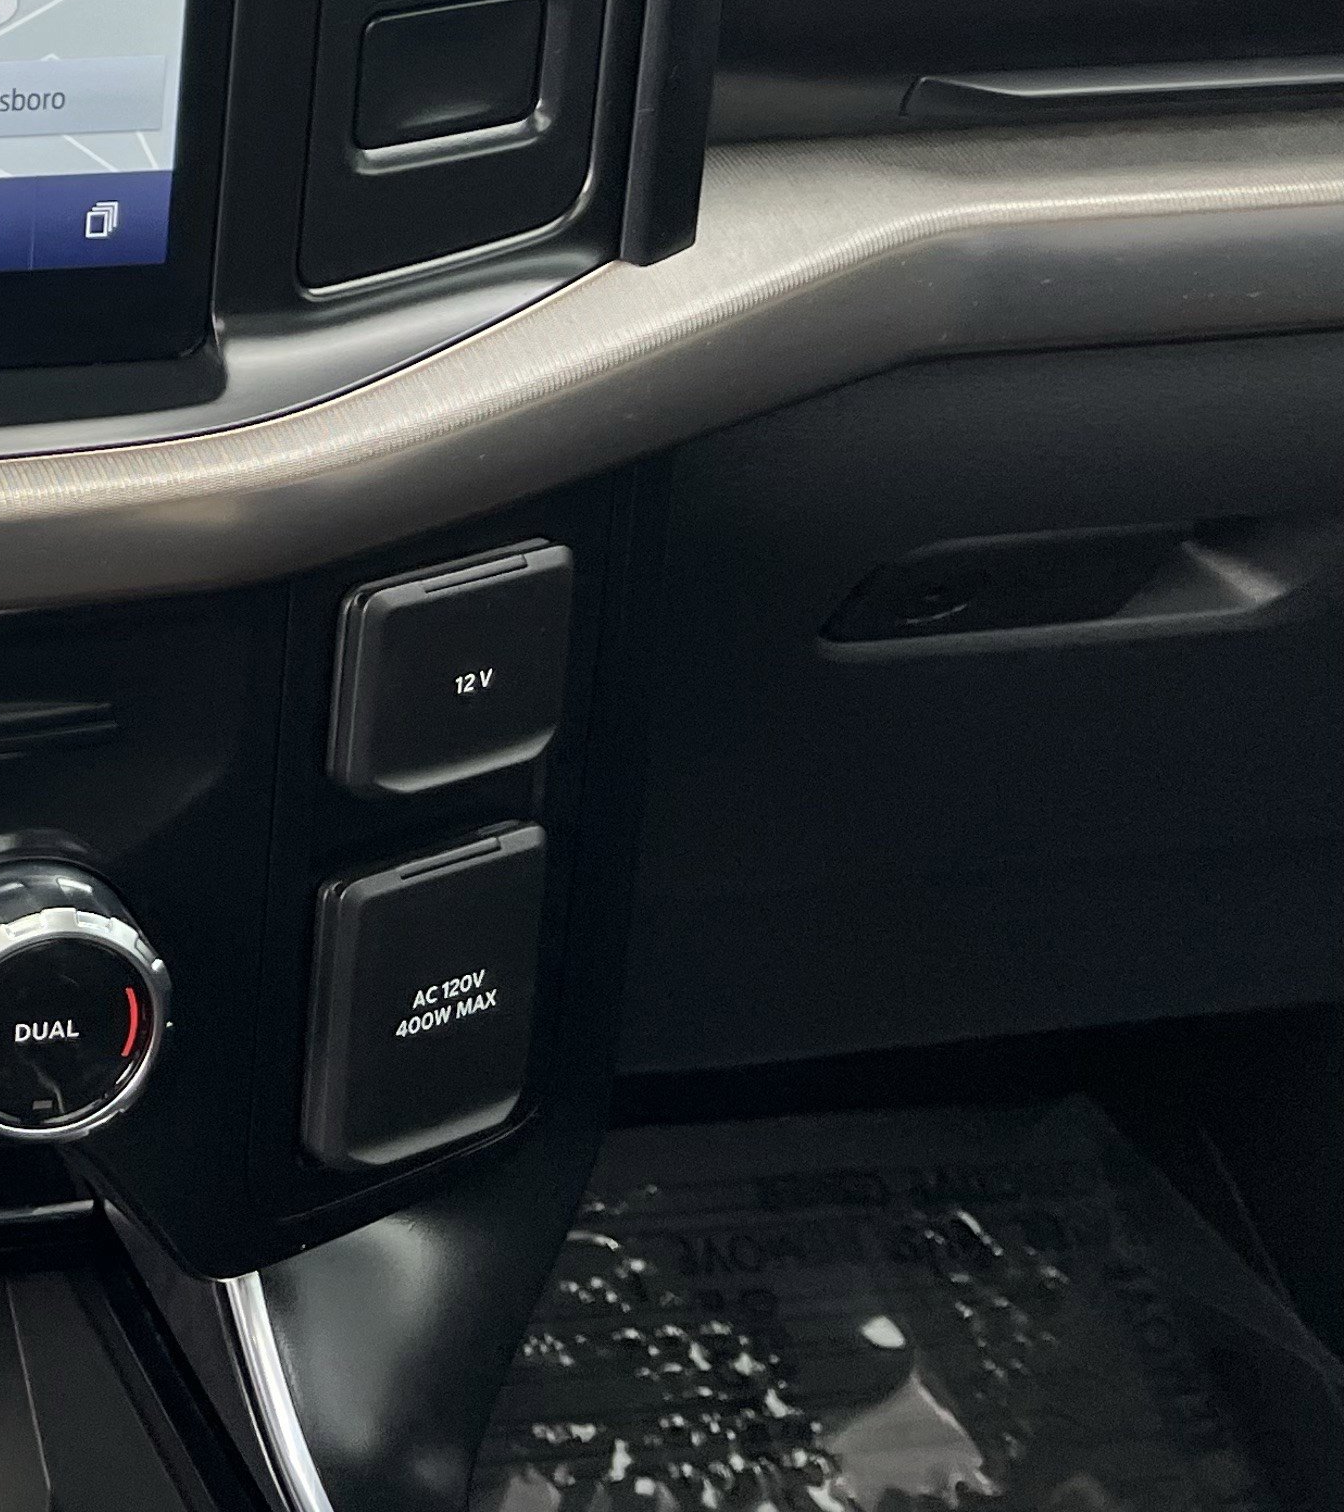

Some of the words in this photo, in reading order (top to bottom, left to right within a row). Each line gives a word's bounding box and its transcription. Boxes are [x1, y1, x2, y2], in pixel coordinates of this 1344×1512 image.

[454, 673, 478, 694] 12
[478, 668, 494, 690] V
[412, 986, 439, 1009] AC
[441, 969, 486, 998] 120V
[395, 1005, 452, 1037] 400W
[455, 989, 498, 1018] MAX
[14, 1019, 80, 1043] DUAL
